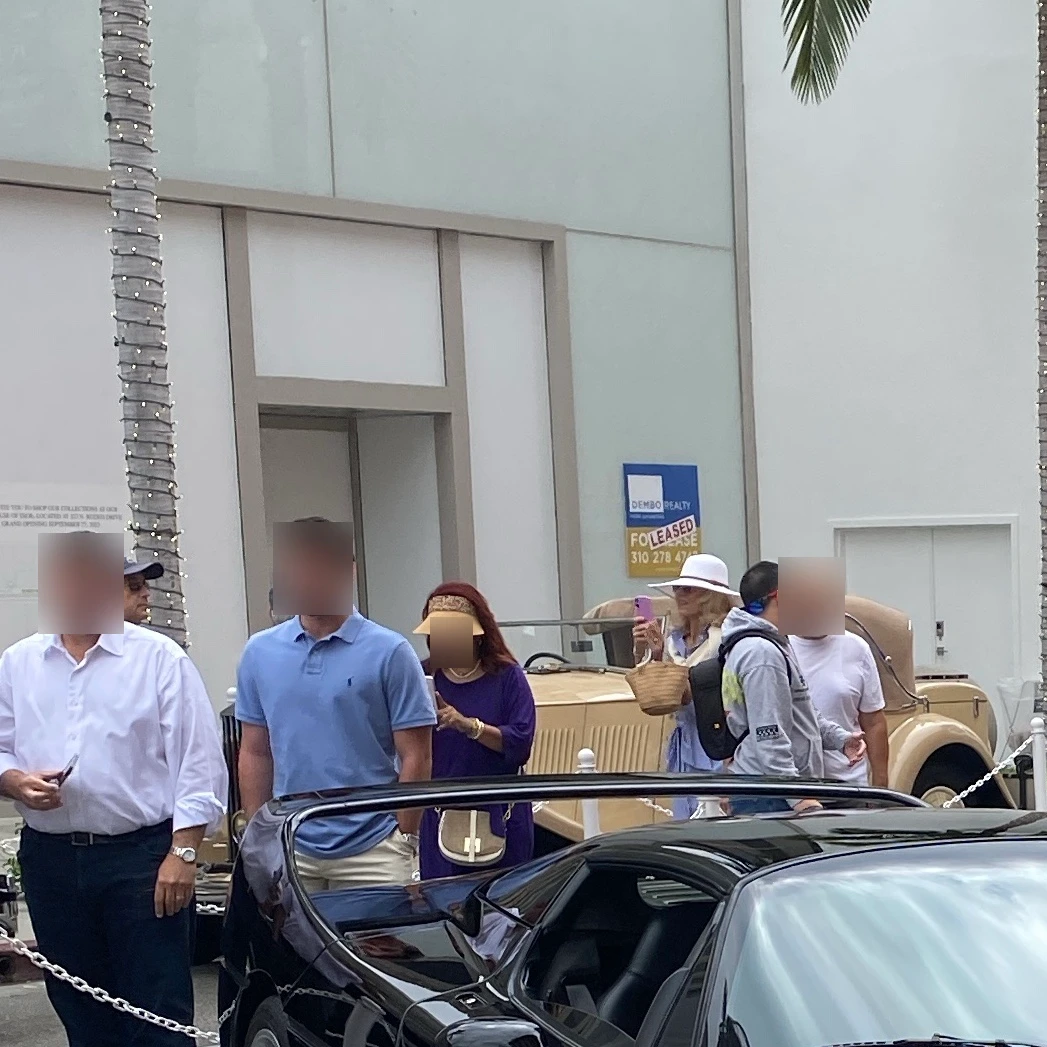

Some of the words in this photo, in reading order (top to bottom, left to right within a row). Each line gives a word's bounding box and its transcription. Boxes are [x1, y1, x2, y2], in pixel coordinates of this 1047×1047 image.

[631, 500, 662, 510] DEMBO
[663, 501, 692, 511] REALTY
[630, 532, 648, 547] FO
[649, 518, 694, 548] LEASED
[630, 551, 649, 564] 310
[652, 551, 671, 564] 278
[674, 551, 698, 564] 47
